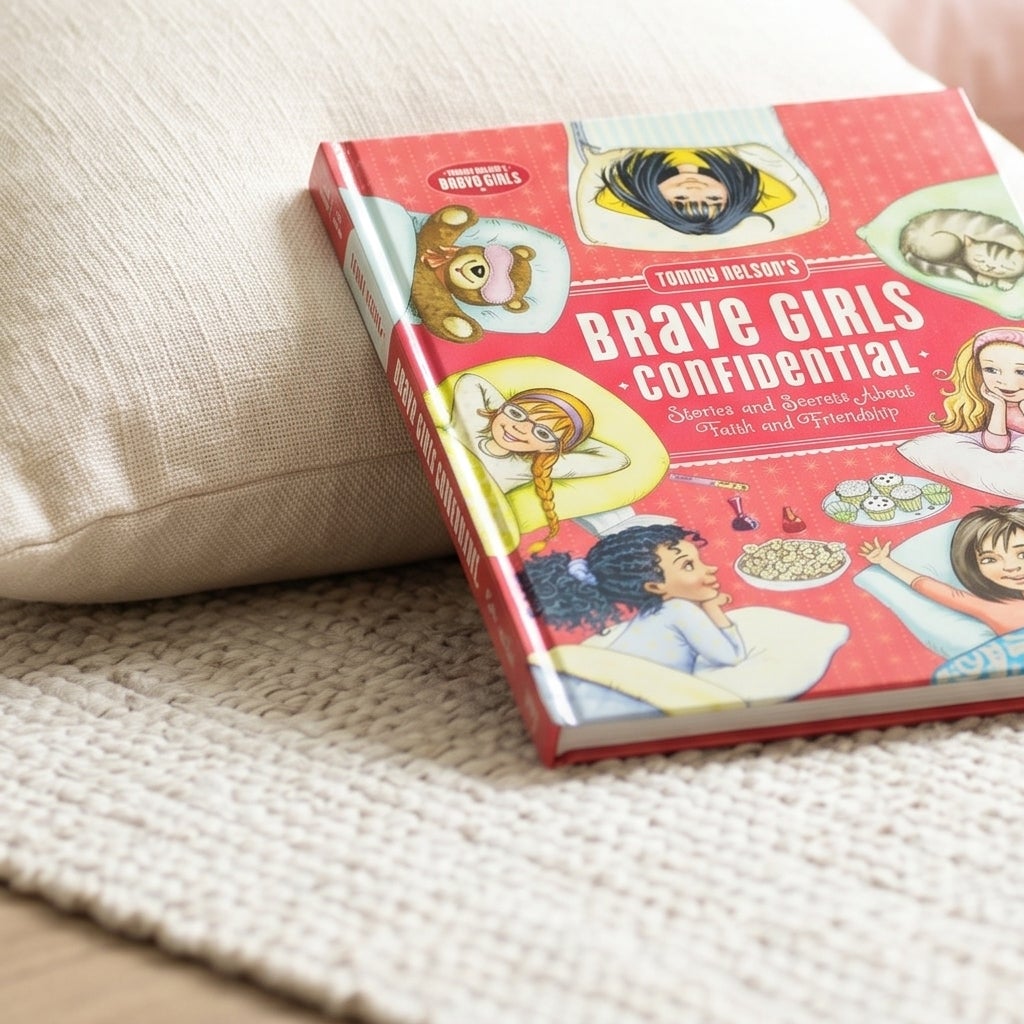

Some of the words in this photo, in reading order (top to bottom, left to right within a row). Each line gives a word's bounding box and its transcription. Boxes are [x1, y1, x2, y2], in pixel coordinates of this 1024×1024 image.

[768, 281, 925, 343] GIRLS
[667, 405, 734, 424] Stories
[742, 396, 776, 415] and
[853, 384, 916, 406] About
[695, 420, 756, 438] Faith
[761, 415, 794, 432] and
[796, 406, 900, 429] Friendship
